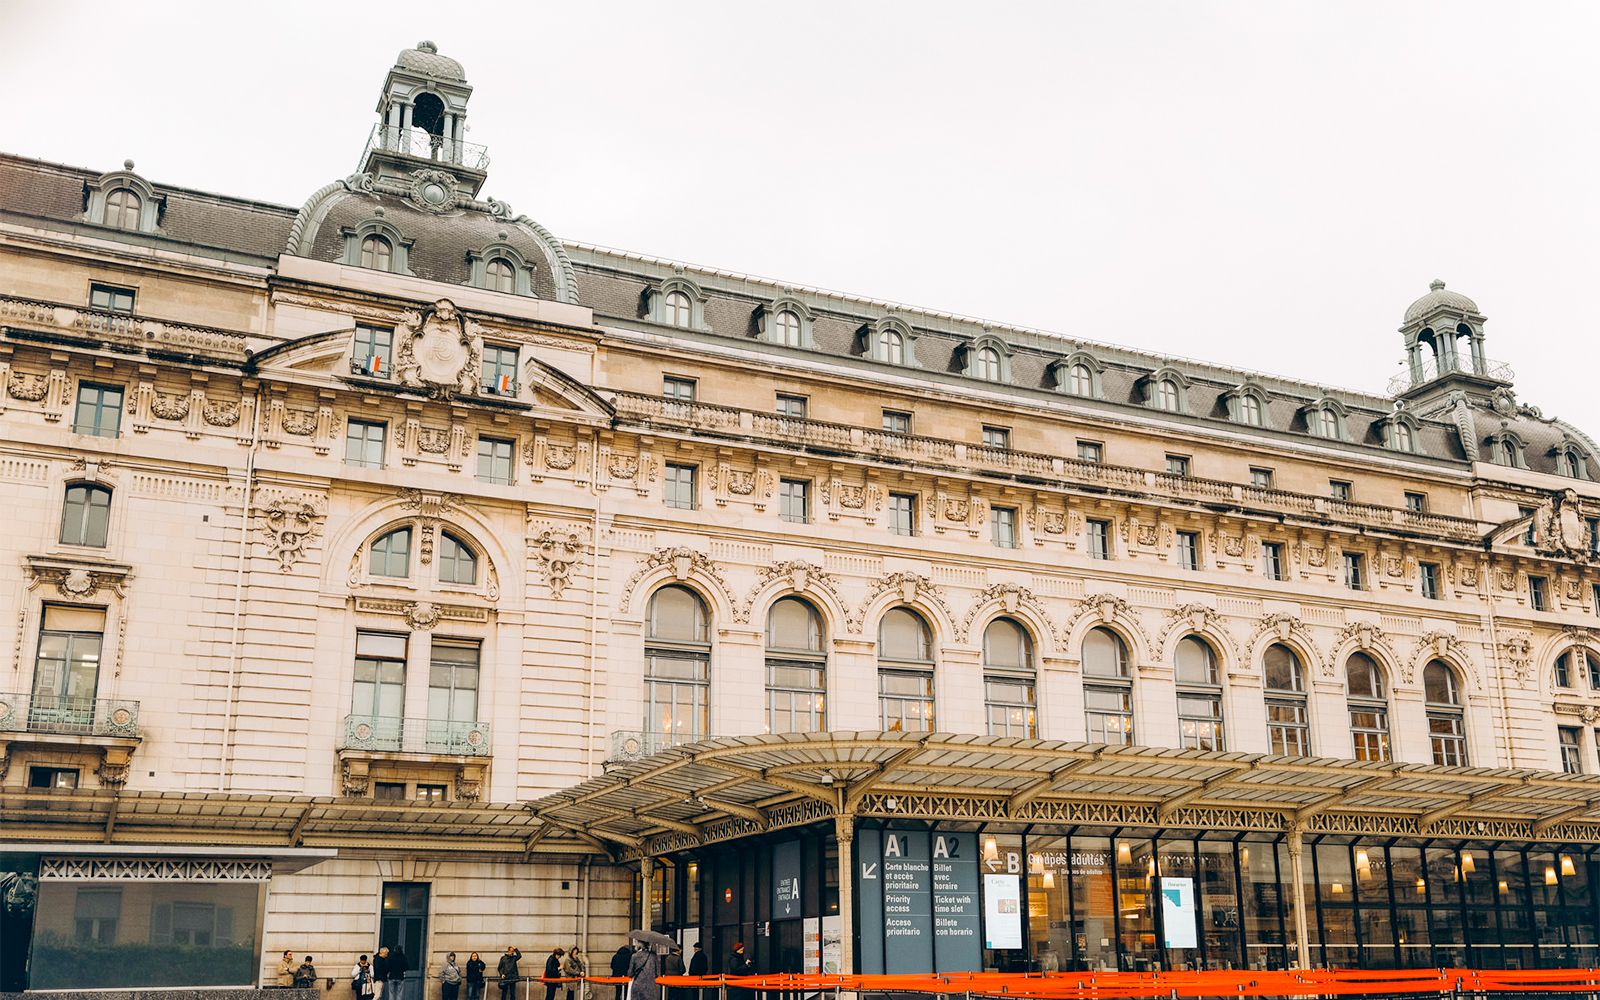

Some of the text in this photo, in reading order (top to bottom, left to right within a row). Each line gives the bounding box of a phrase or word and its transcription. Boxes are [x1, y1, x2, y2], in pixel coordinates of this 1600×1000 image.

[885, 834, 908, 857] A1
[933, 836, 960, 859] A2
[1007, 852, 1020, 873] B
[1028, 853, 1104, 867] Groupes adultes
[885, 863, 929, 871] Carte blanche
[934, 864, 952, 872] Billet
[894, 872, 913, 880] accès
[791, 877, 799, 900] A
[885, 882, 919, 890] prioritaire
[934, 882, 958, 890] horaire
[886, 895, 911, 904] Priority
[935, 895, 971, 904] Ticket with
[886, 918, 911, 926] Acceso
[935, 918, 958, 926] Billete
[886, 928, 921, 937] prioritario
[949, 928, 973, 936] horario
